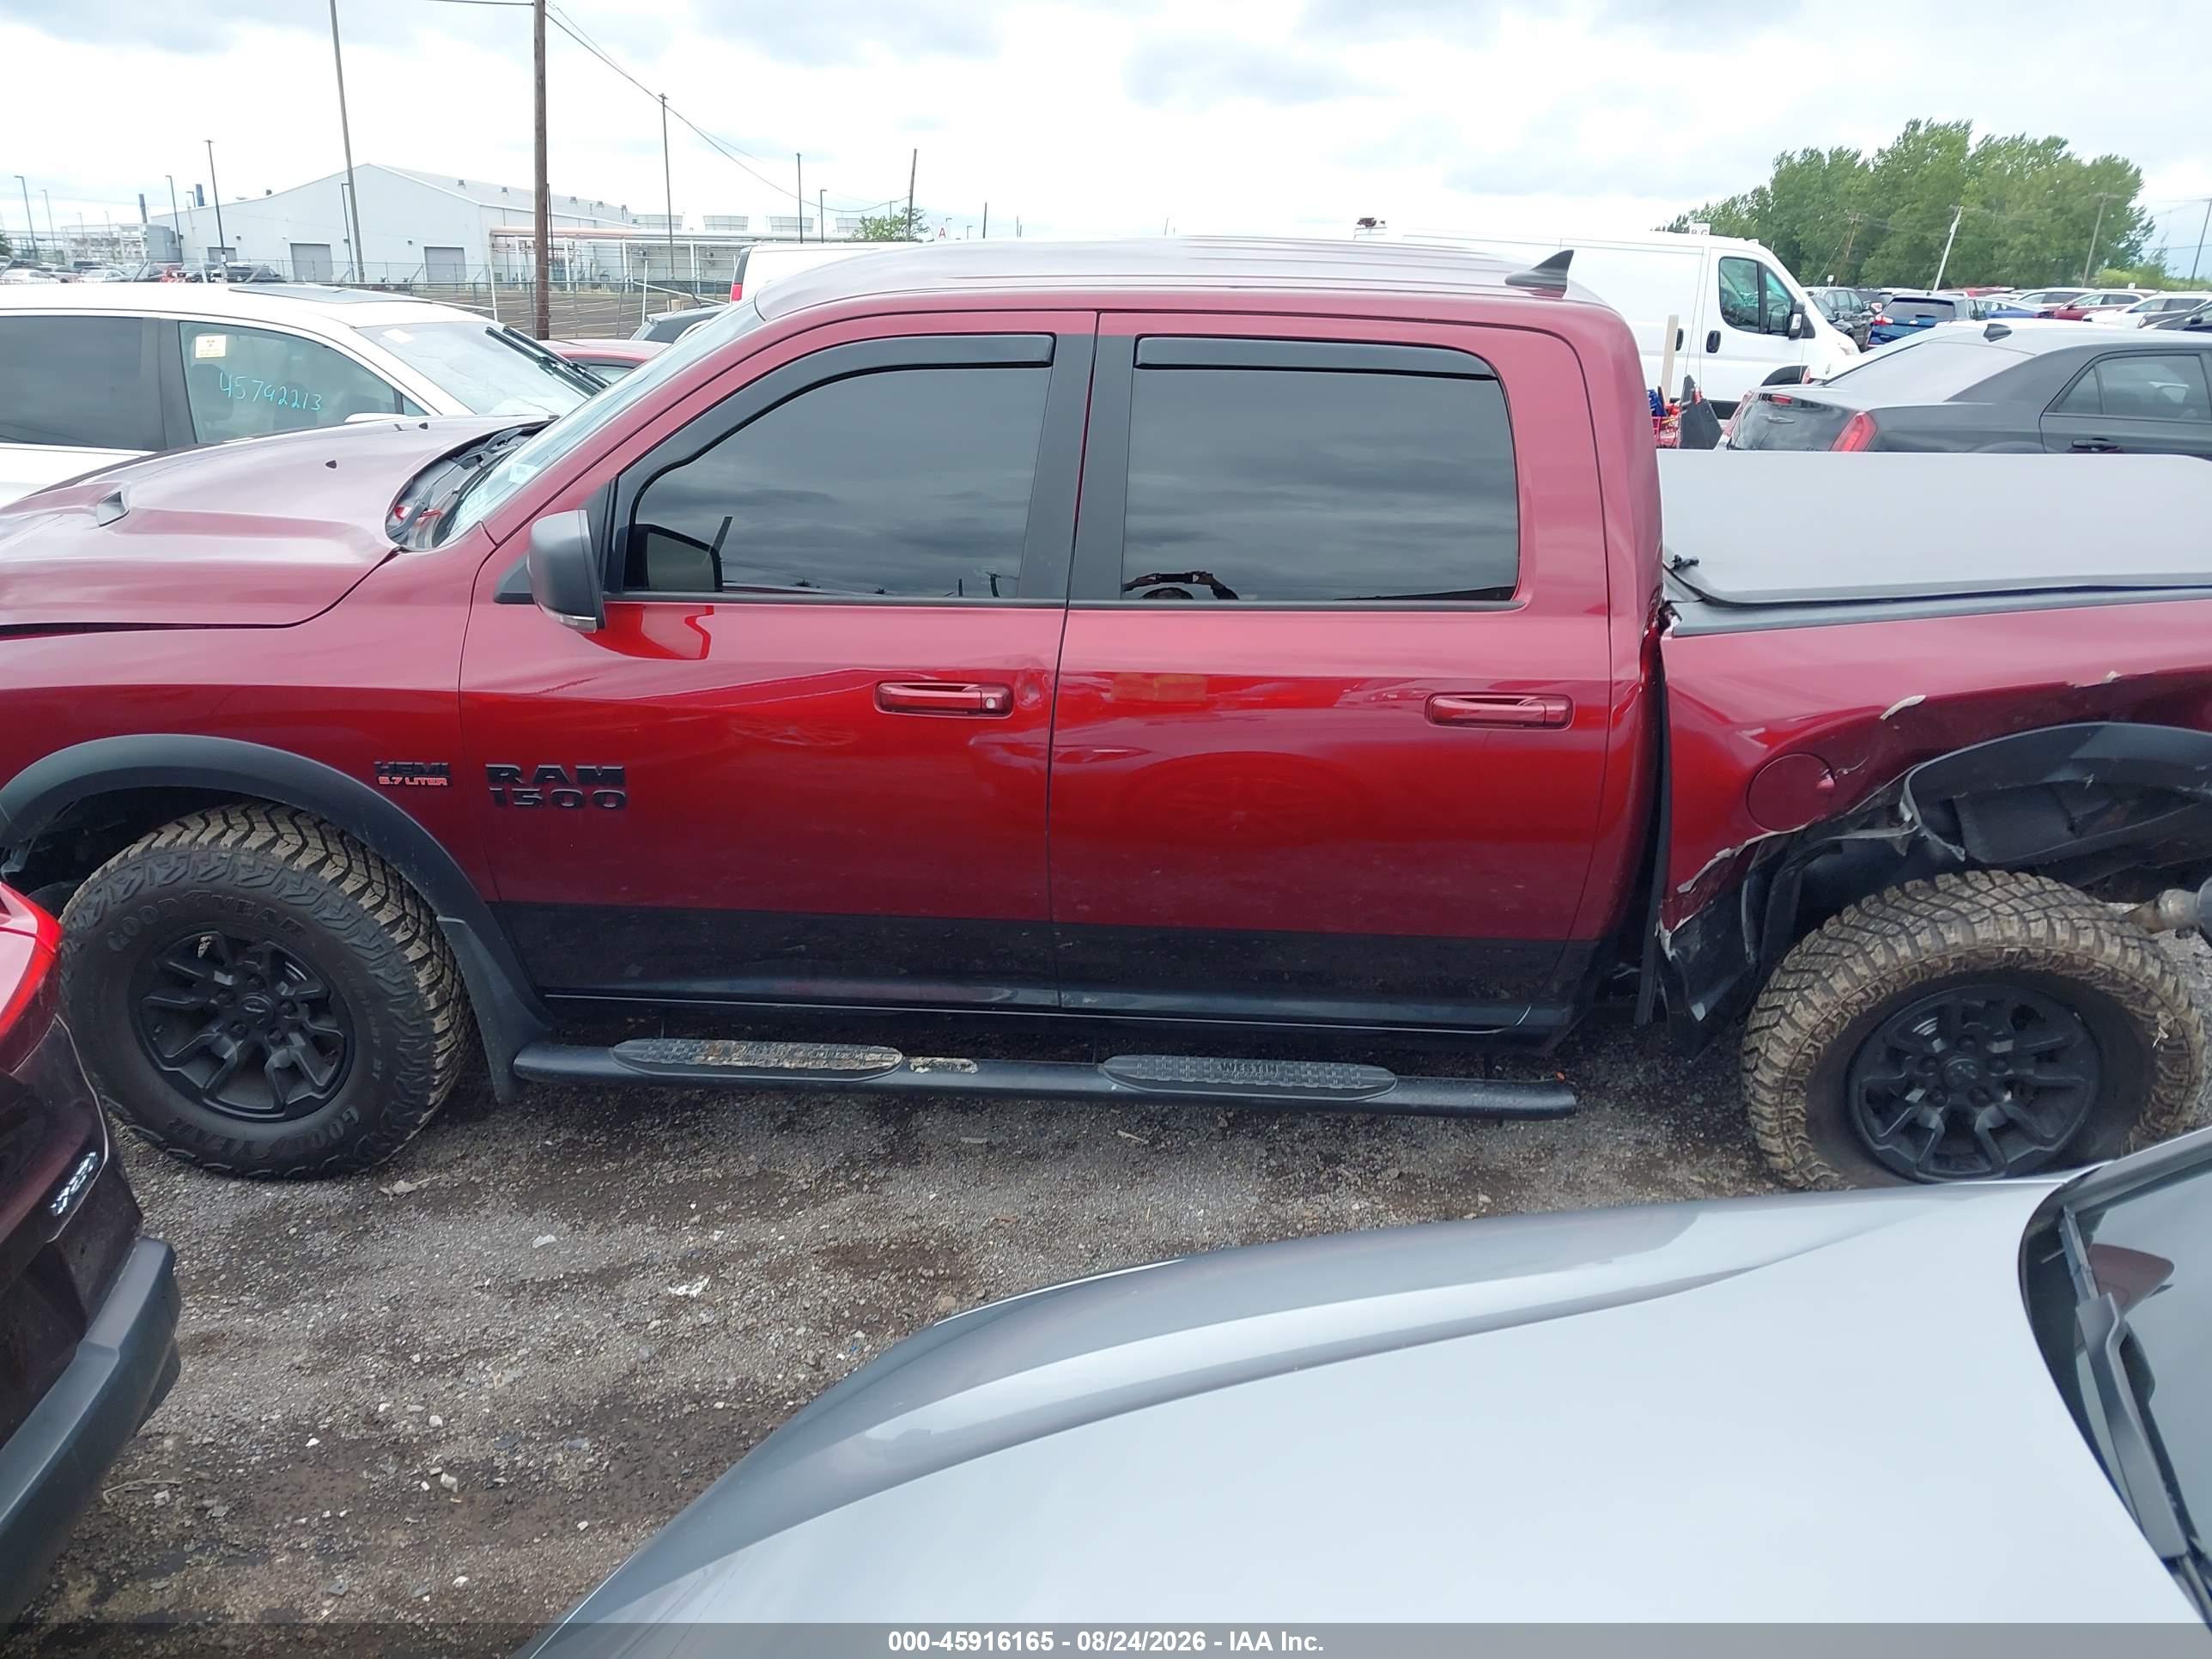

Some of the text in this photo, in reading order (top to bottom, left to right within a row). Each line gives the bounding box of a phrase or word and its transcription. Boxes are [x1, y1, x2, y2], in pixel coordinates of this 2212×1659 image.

[939, 227, 946, 239] A
[374, 761, 451, 777] HEMI
[485, 763, 626, 785] RAM
[378, 775, 448, 786] 5.7 LITER
[489, 787, 627, 808] 1500
